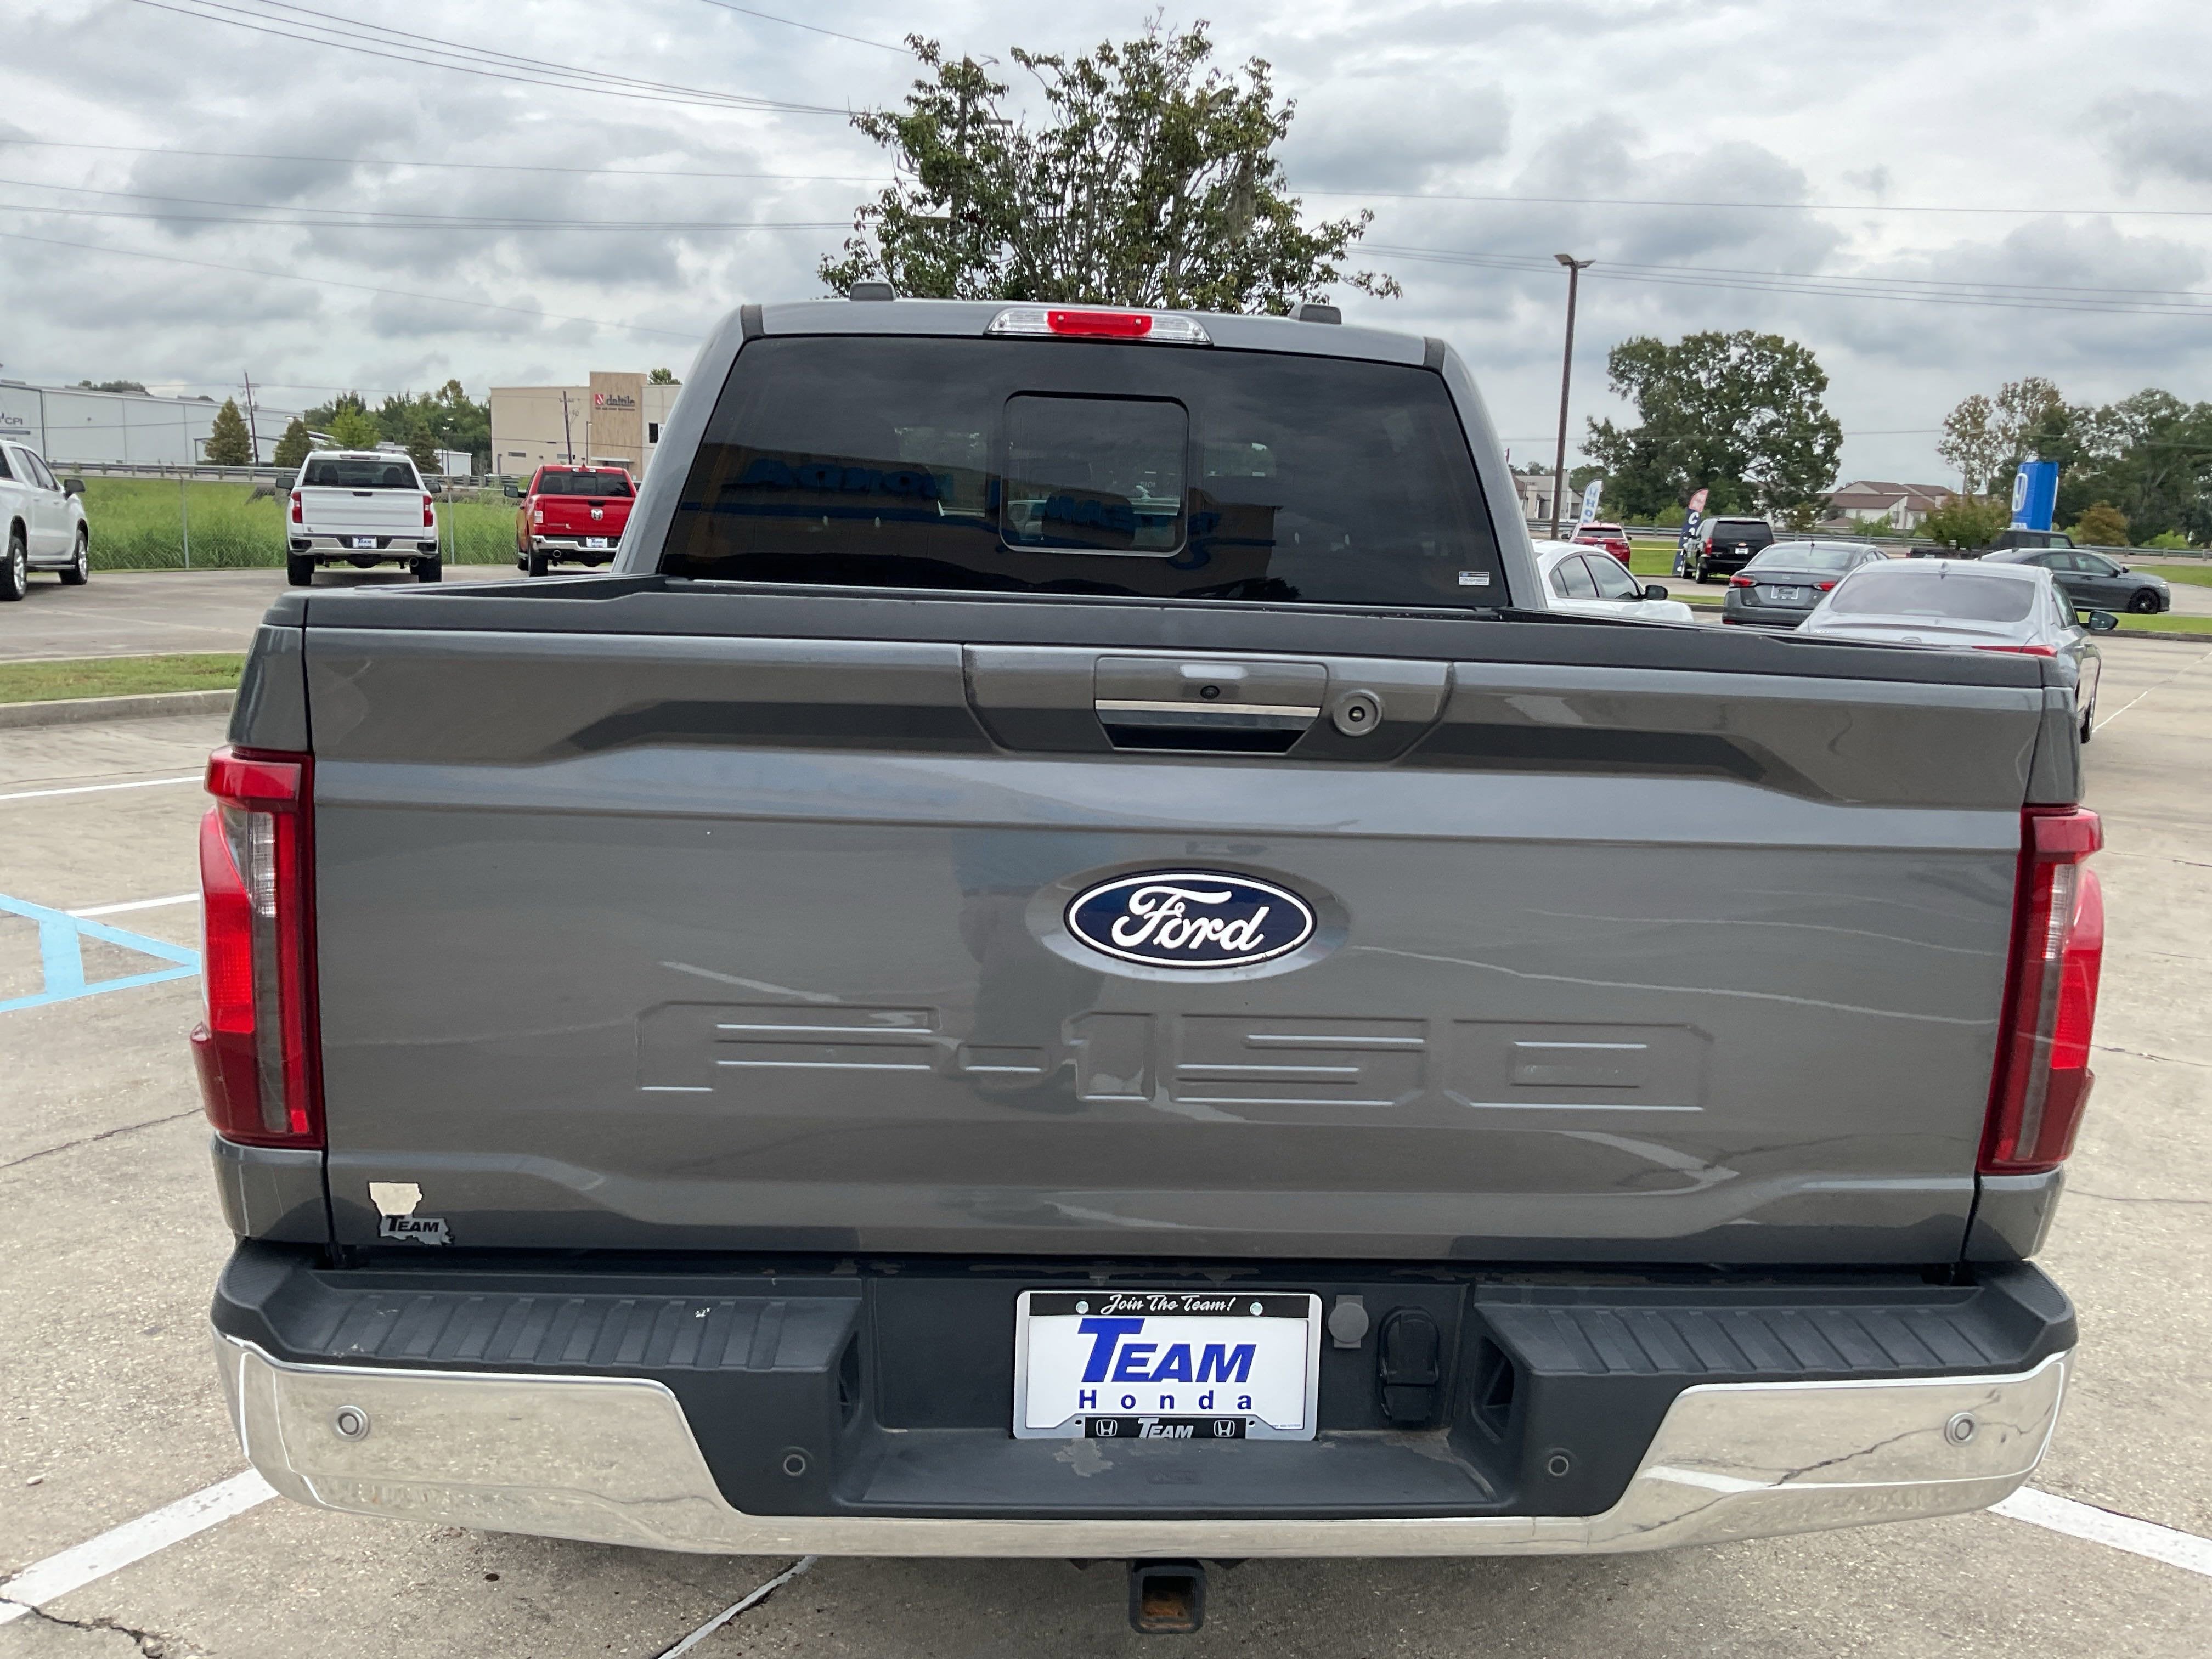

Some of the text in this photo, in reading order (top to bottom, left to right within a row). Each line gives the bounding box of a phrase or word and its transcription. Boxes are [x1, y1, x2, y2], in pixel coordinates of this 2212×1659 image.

[1111, 886, 1269, 951] Ford
[636, 1000, 1713, 1111] F-150
[385, 1214, 439, 1233] TEAM
[1100, 1294, 1236, 1314] Join The Team!
[1077, 1318, 1257, 1383] TEAM
[1079, 1389, 1252, 1410] Honda
[1137, 1417, 1194, 1438] TEAM
